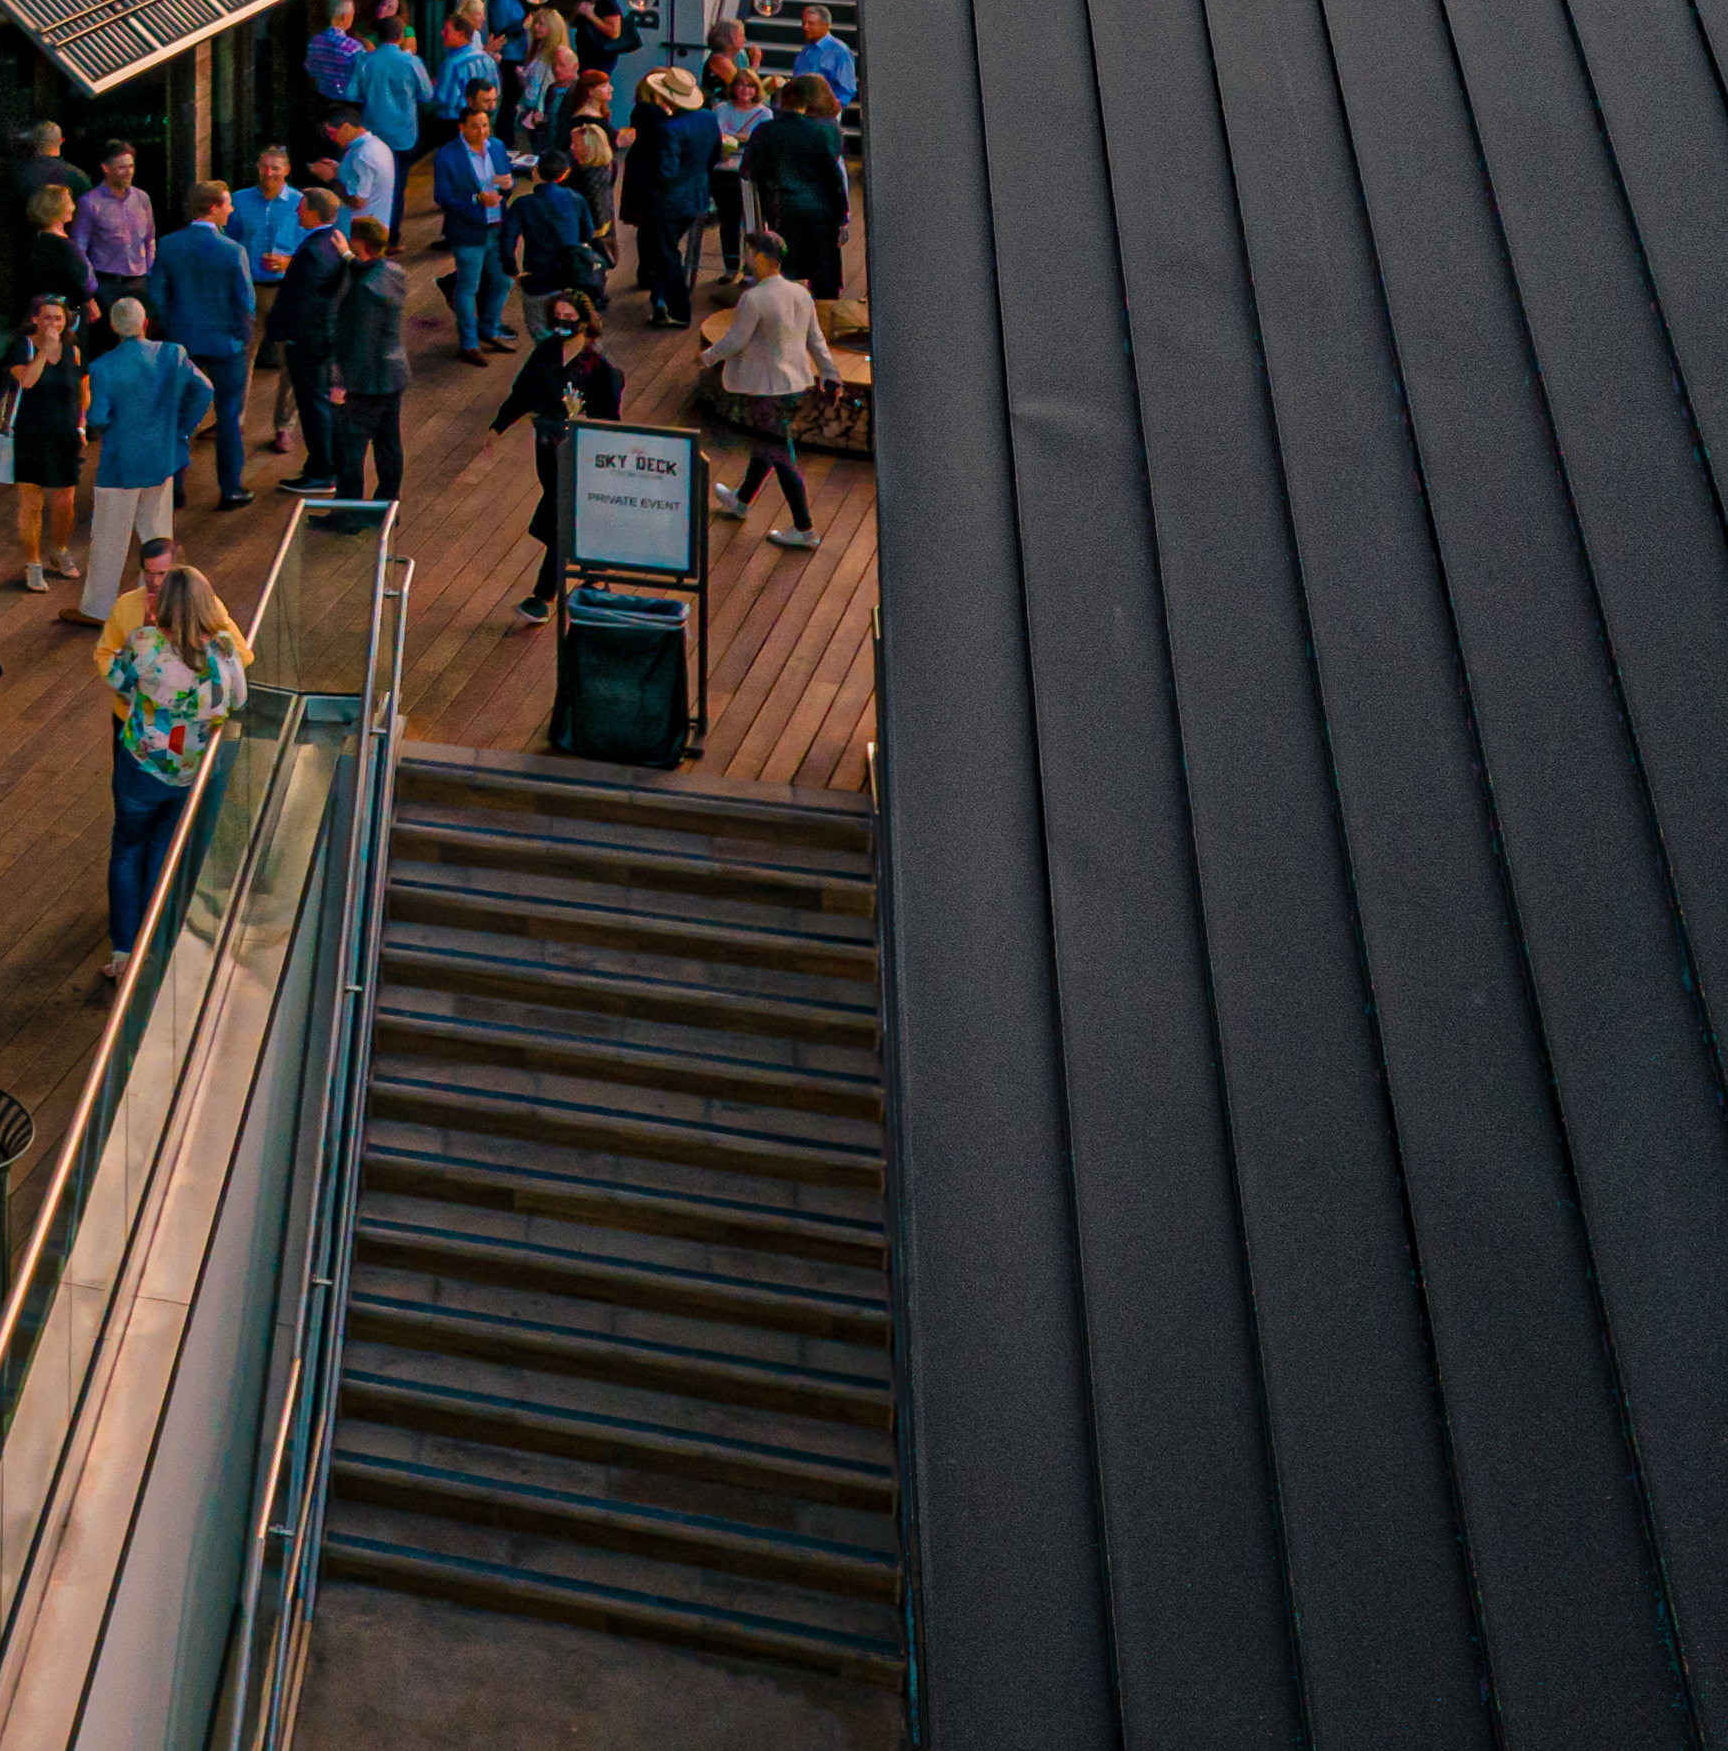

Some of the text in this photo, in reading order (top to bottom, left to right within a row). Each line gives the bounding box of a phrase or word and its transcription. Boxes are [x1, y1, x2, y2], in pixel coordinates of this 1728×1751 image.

[594, 453, 628, 469] SKY
[635, 455, 677, 477] DECK
[587, 492, 682, 511] PRIVATE EVENT
